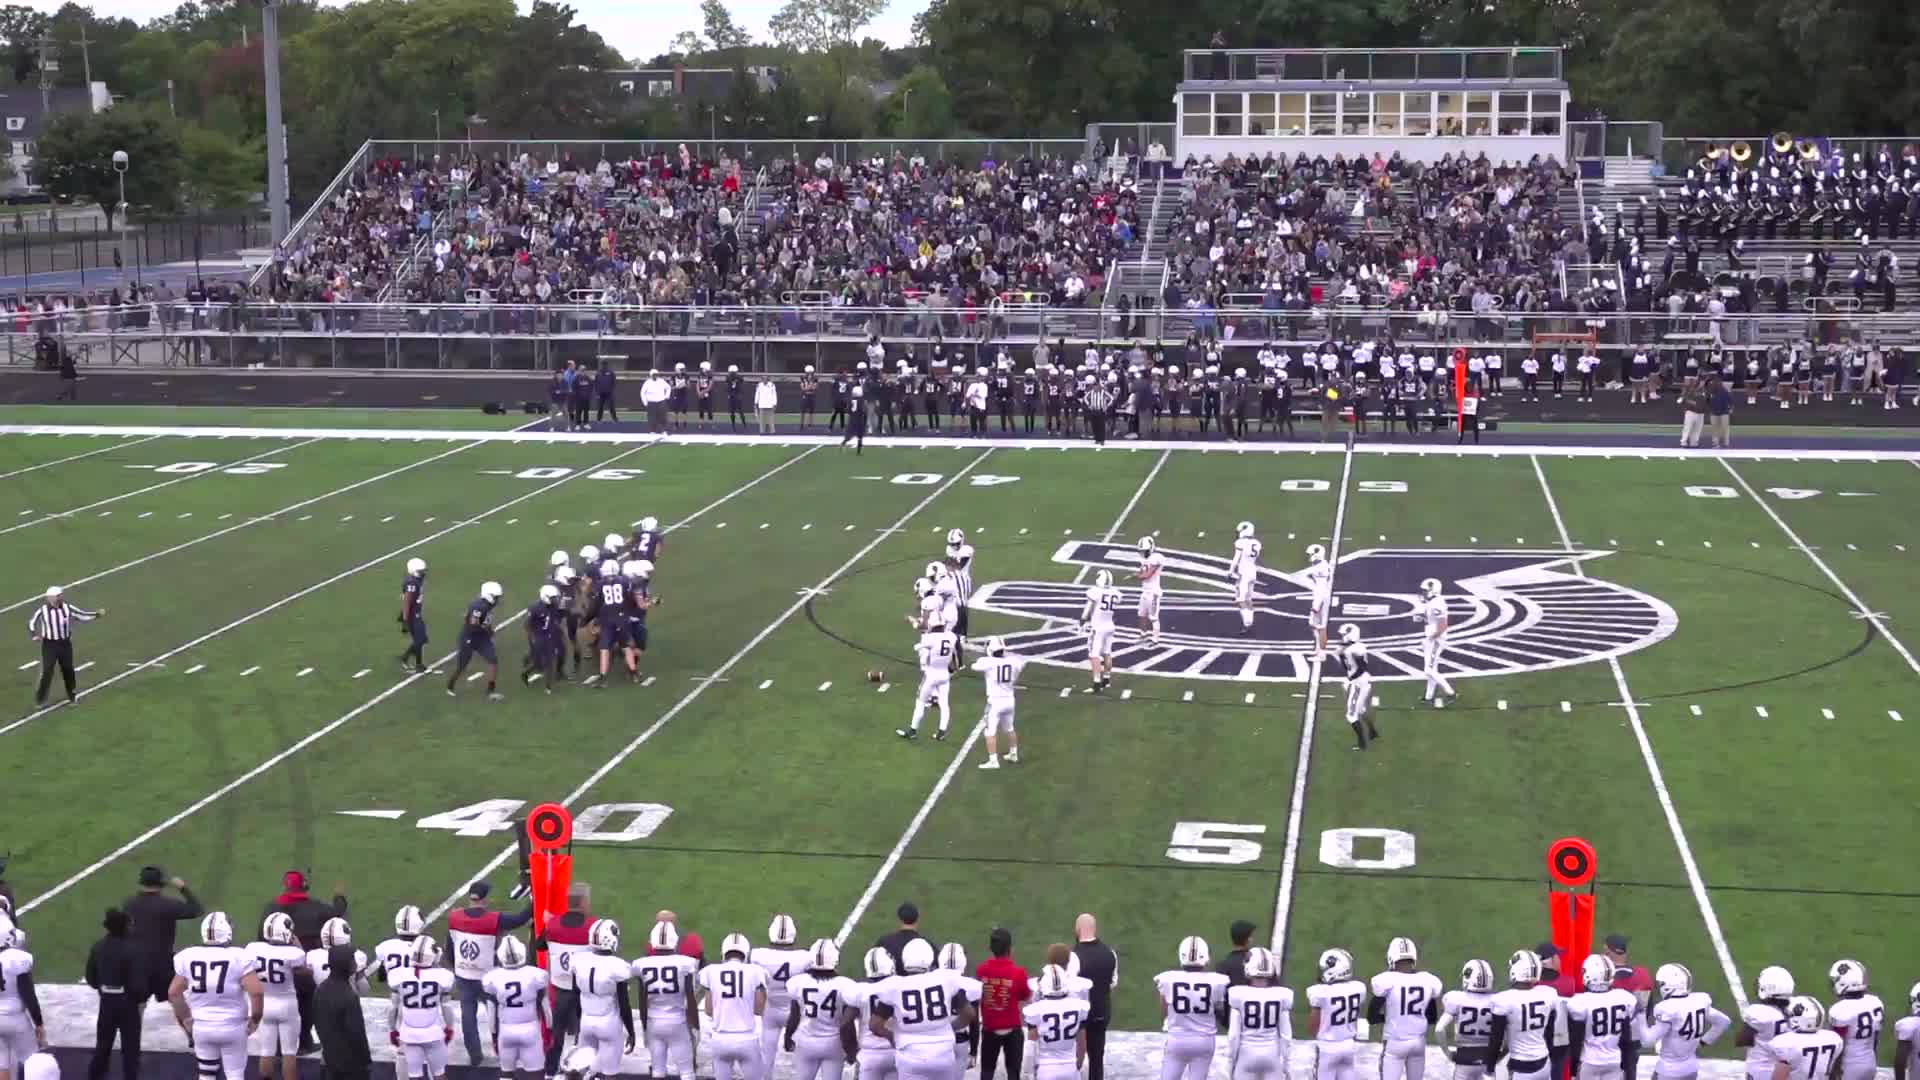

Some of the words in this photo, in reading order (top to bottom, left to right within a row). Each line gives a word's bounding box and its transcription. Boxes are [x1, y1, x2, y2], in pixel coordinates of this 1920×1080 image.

[639, 533, 651, 552] 2
[602, 583, 624, 605] 88
[940, 640, 951, 656] 6
[996, 664, 1012, 683] 10
[190, 961, 229, 994] 97
[256, 956, 285, 984] 26
[588, 966, 596, 994] 1
[642, 966, 680, 994] 29
[720, 970, 744, 999] 91
[773, 961, 792, 990] 4
[402, 981, 439, 1008] 22
[505, 981, 524, 1008] 2
[802, 987, 838, 1019] 54
[902, 984, 948, 1025] 98
[1172, 982, 1212, 1015] 63
[1400, 986, 1425, 1015] 12
[1243, 1000, 1281, 1029] 80
[1330, 993, 1361, 1026] 28
[1521, 1000, 1545, 1032] 15
[1592, 1004, 1627, 1037] 86
[1042, 1010, 1079, 1043] 32
[1678, 1008, 1706, 1041] 40
[1802, 1044, 1837, 1079] 77
